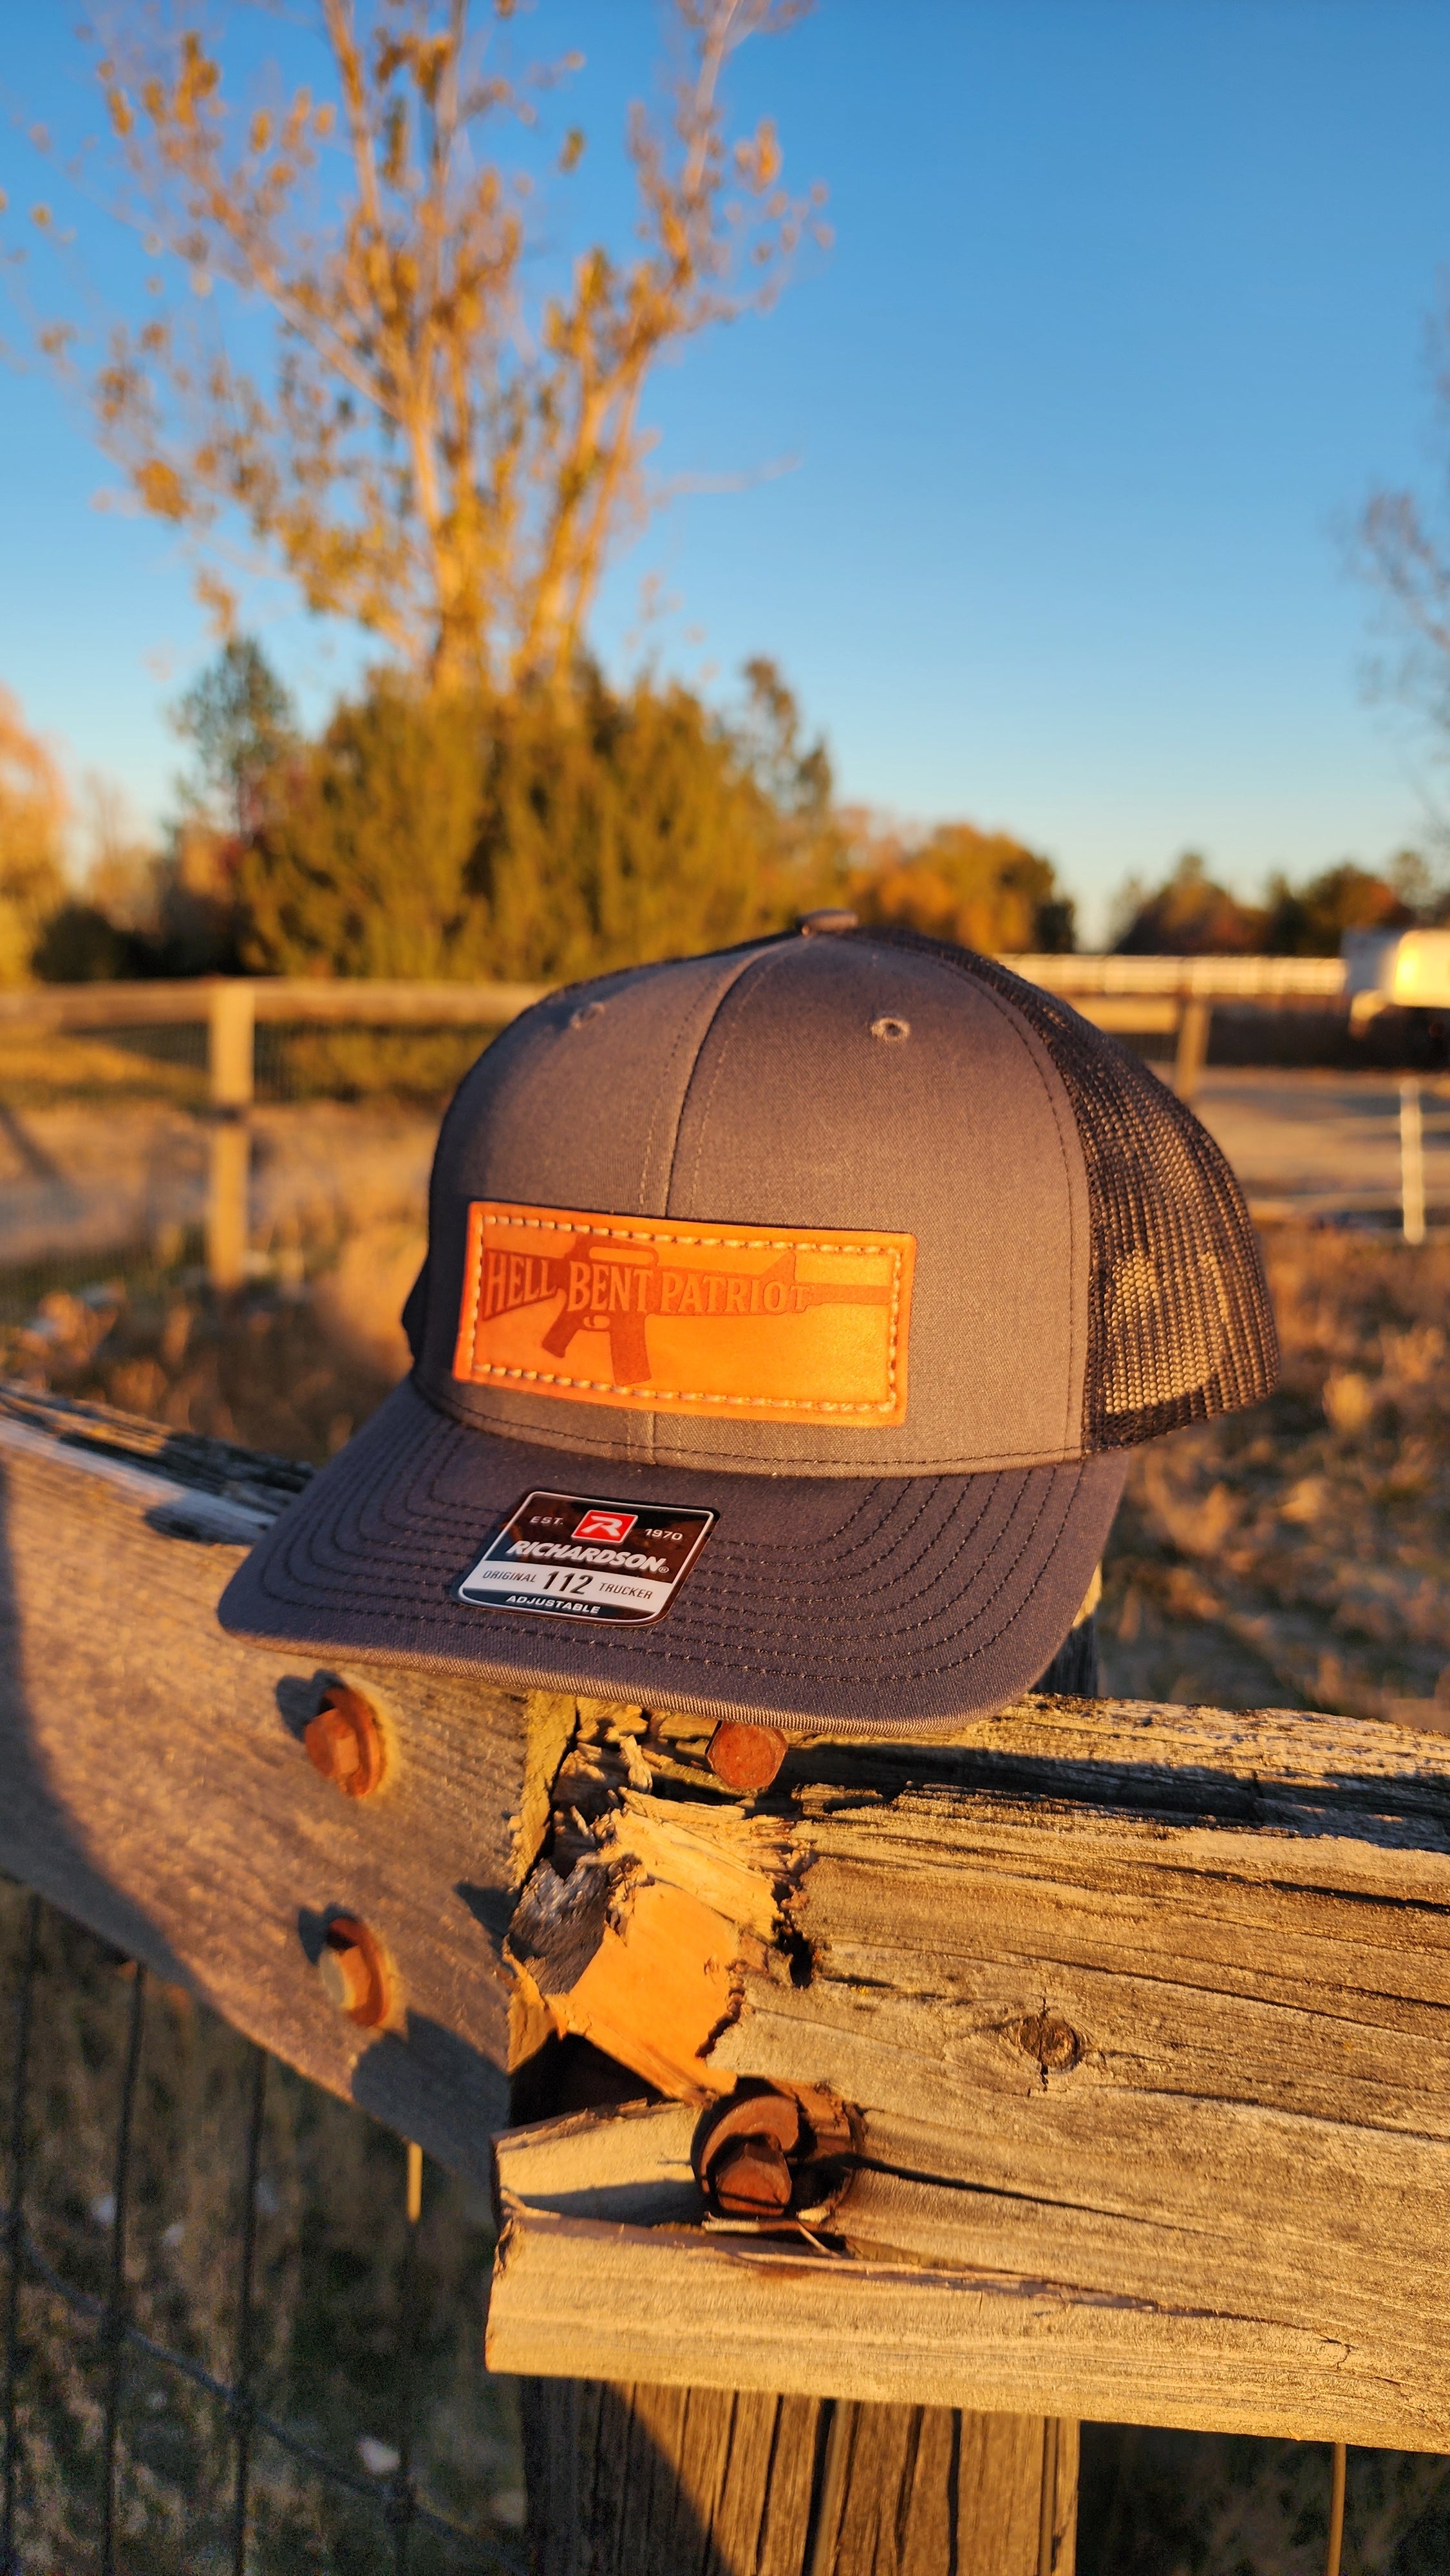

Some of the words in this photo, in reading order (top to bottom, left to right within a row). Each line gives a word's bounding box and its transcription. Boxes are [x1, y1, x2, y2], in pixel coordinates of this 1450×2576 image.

[483, 1250, 558, 1315] HELL
[567, 1260, 655, 1312] BENT
[660, 1270, 811, 1314] PATRIOT
[529, 1515, 564, 1526] EST.
[579, 1515, 623, 1537] R
[645, 1528, 684, 1541] 1970
[482, 1570, 536, 1583] ORIGINAL
[542, 1570, 594, 1595] 112
[599, 1582, 654, 1600] TRUCKER
[505, 1595, 601, 1615] ADJUSTABLE
